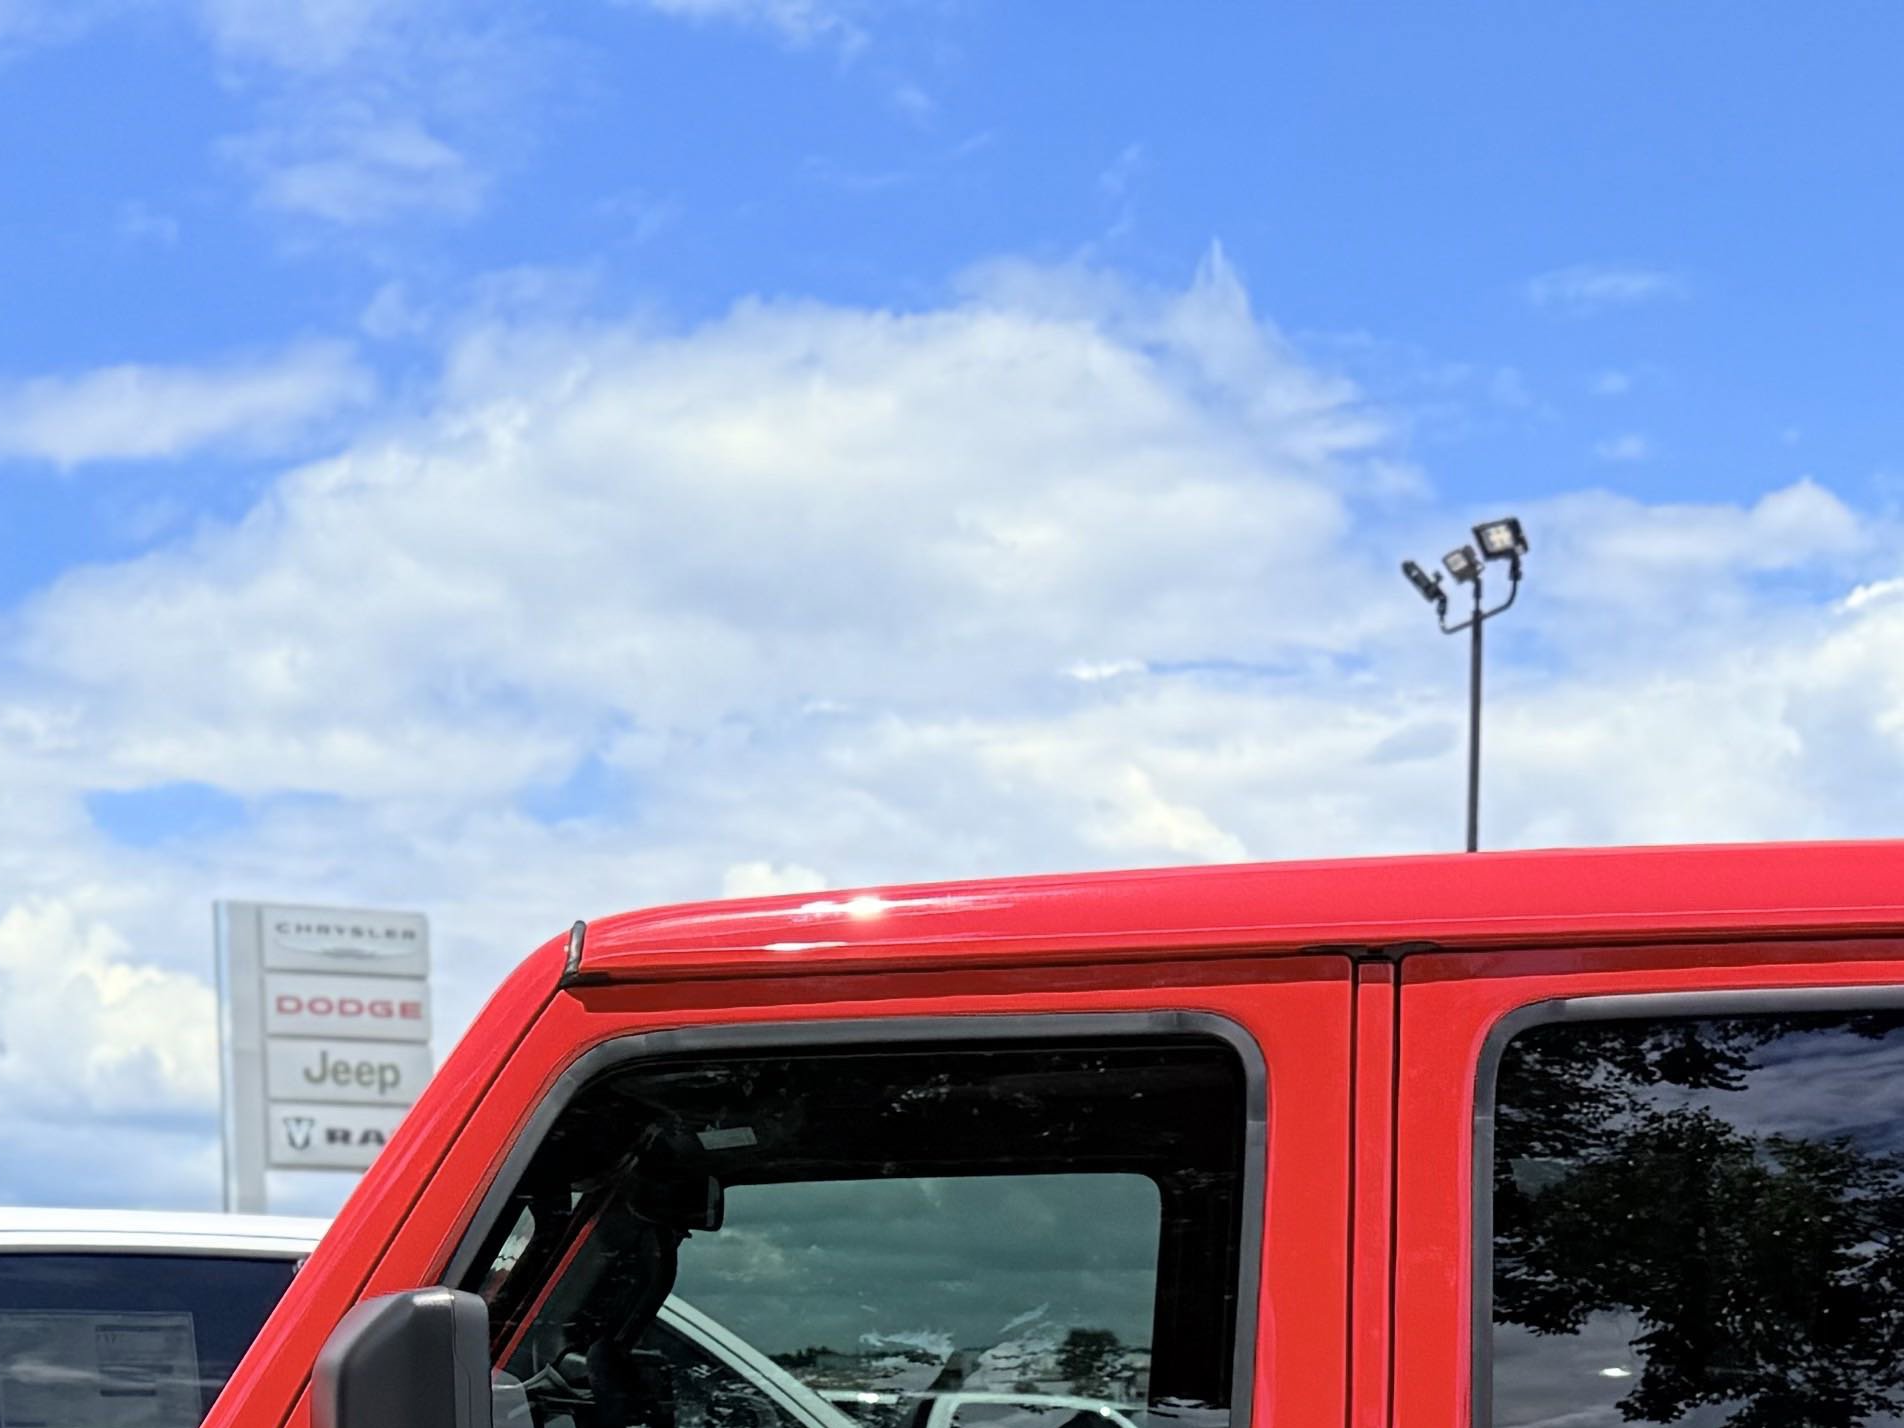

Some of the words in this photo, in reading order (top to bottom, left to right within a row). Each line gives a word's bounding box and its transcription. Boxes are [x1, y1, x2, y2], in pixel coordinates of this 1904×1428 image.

[275, 920, 417, 940] CHRYSLER
[275, 995, 423, 1019] DODGE
[303, 1050, 402, 1096] Jeep
[325, 1126, 393, 1146] RA
